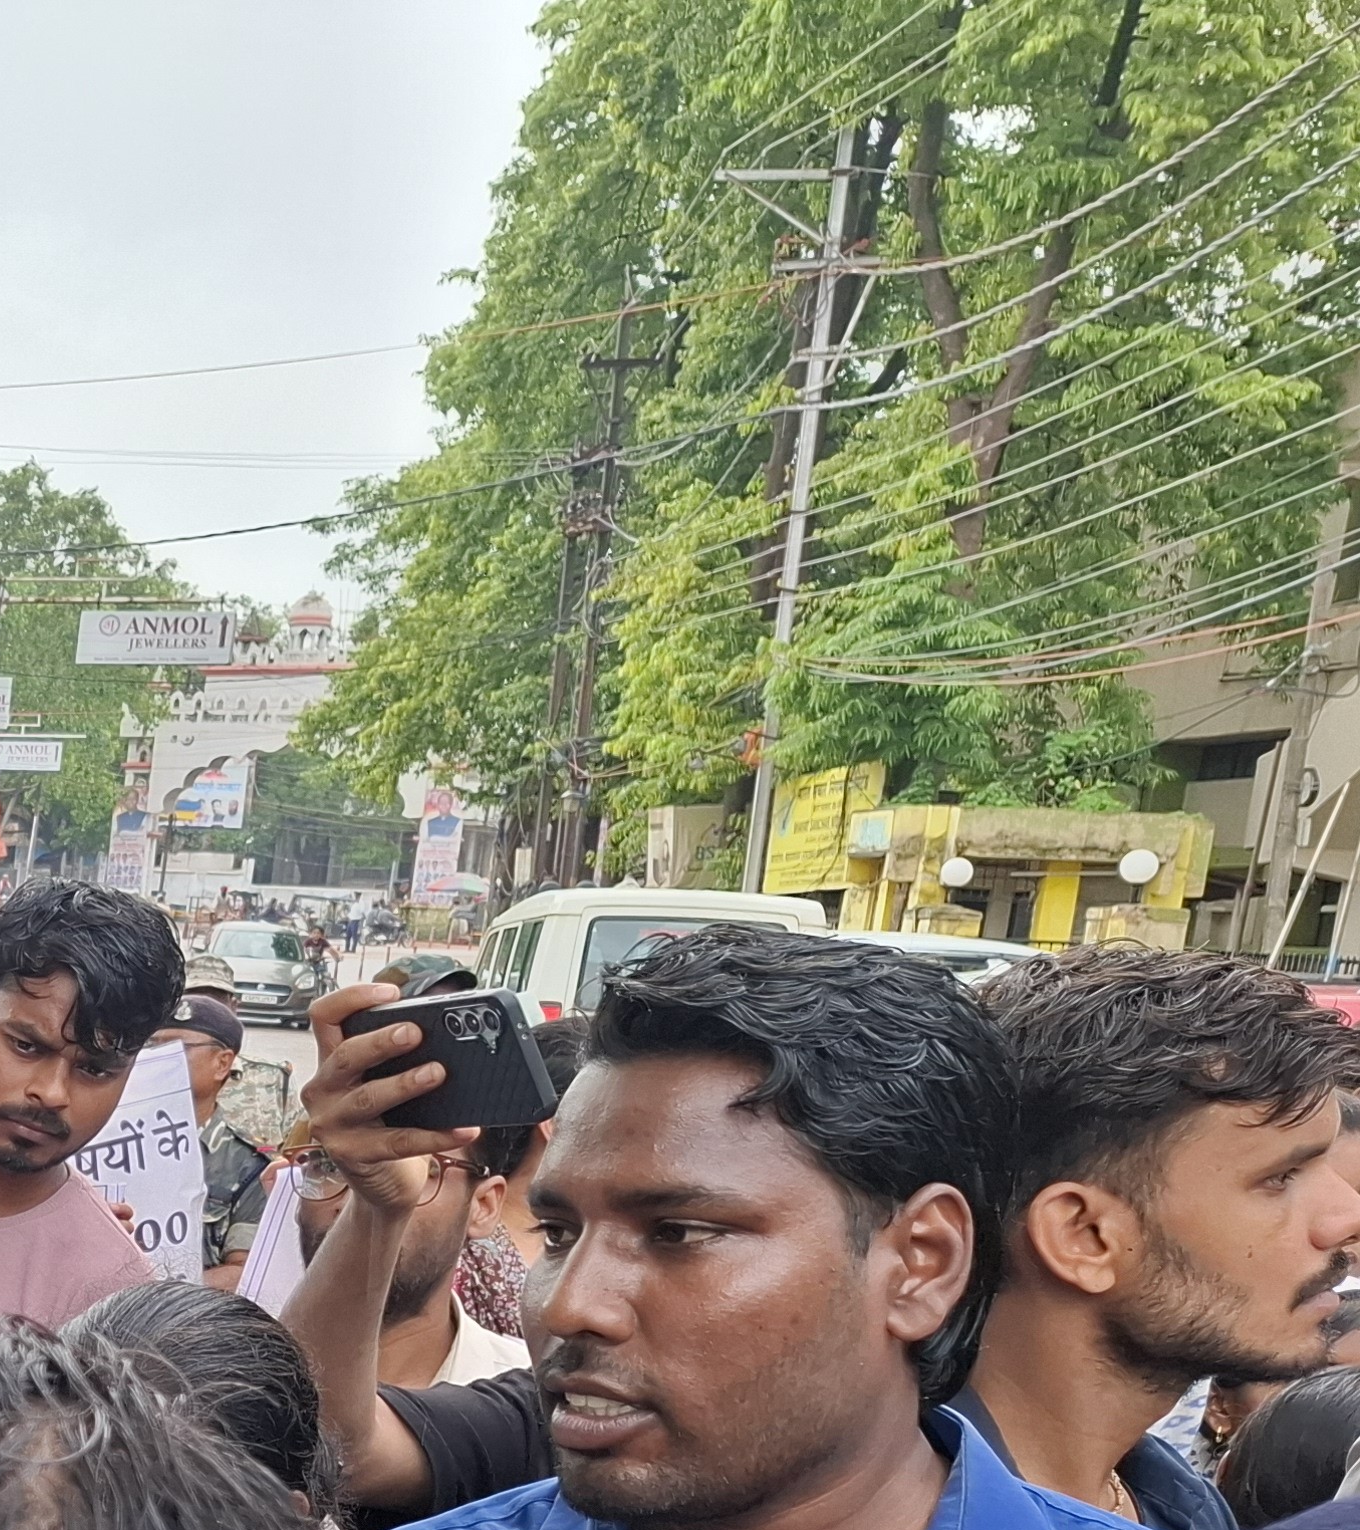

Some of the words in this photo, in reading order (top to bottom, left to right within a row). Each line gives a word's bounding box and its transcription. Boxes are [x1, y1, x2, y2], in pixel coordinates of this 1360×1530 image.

[124, 616, 213, 635] ANMOL
[127, 638, 207, 651] JEWELLERS
[6, 745, 50, 754] ANMOL
[75, 1118, 146, 1182] षयों
[151, 1109, 190, 1161] के
